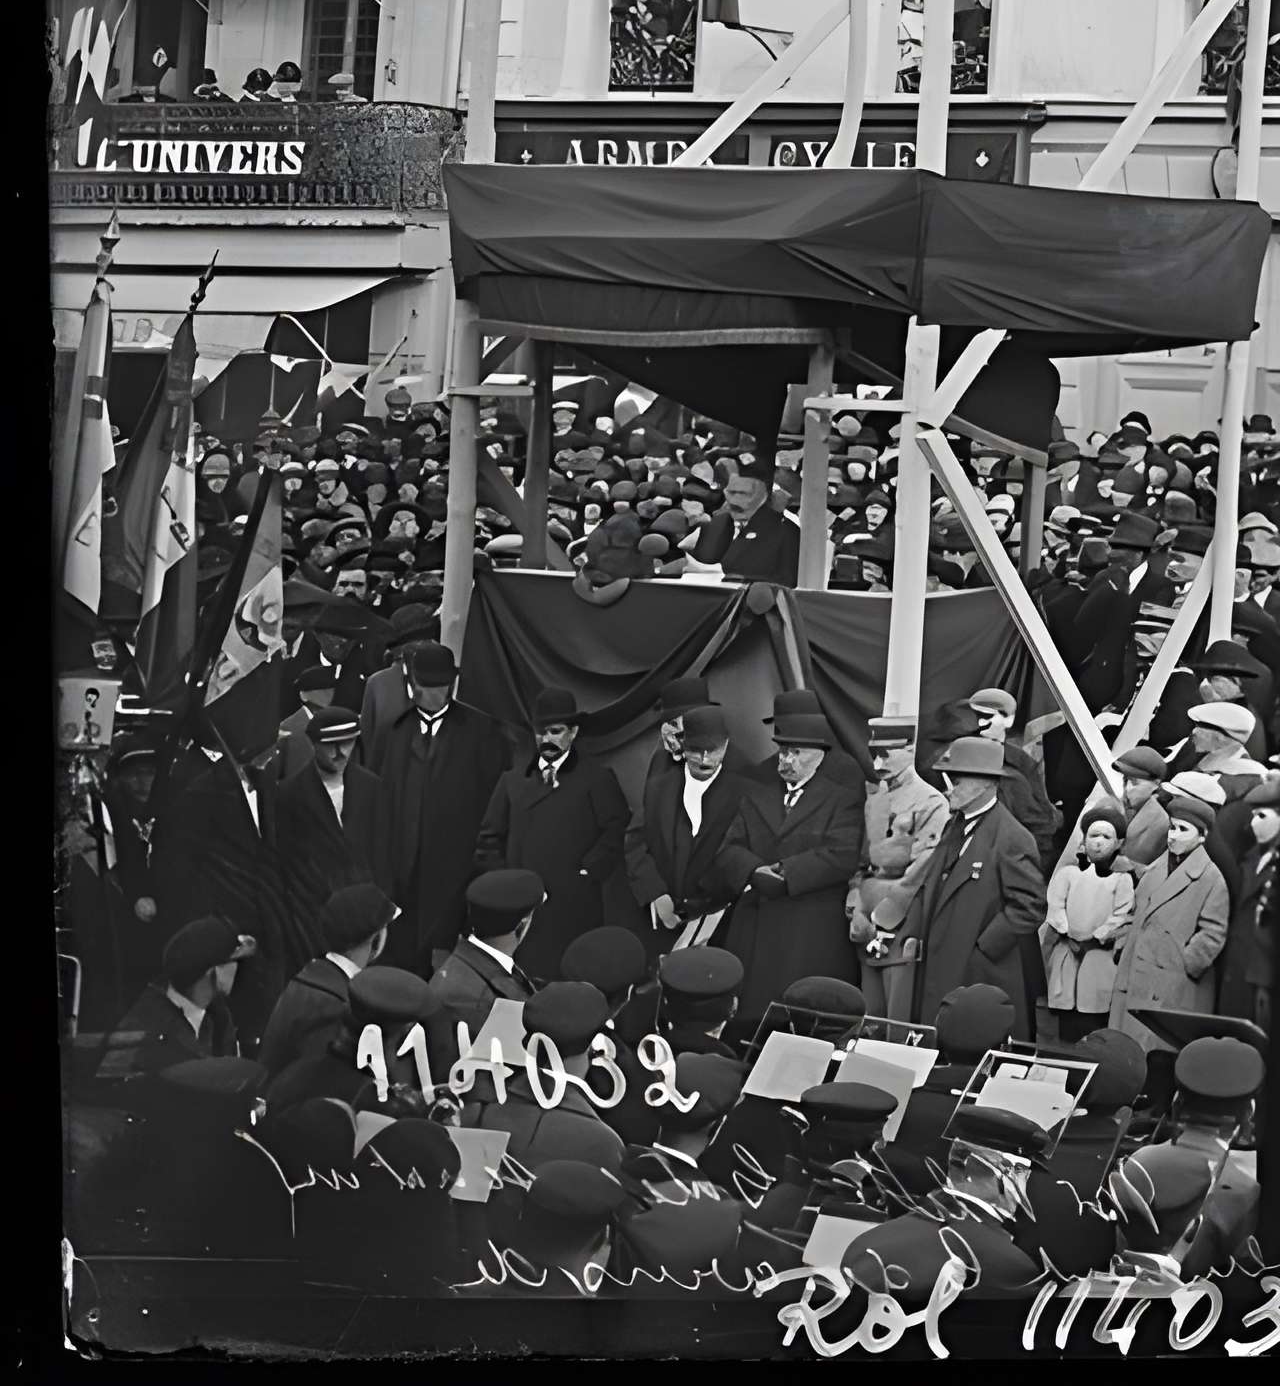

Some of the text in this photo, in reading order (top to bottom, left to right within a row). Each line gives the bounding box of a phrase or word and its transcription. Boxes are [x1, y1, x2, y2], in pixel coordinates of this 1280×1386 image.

[95, 137, 306, 175] L'UNIVERS
[565, 138, 935, 169] ARME CYLE
